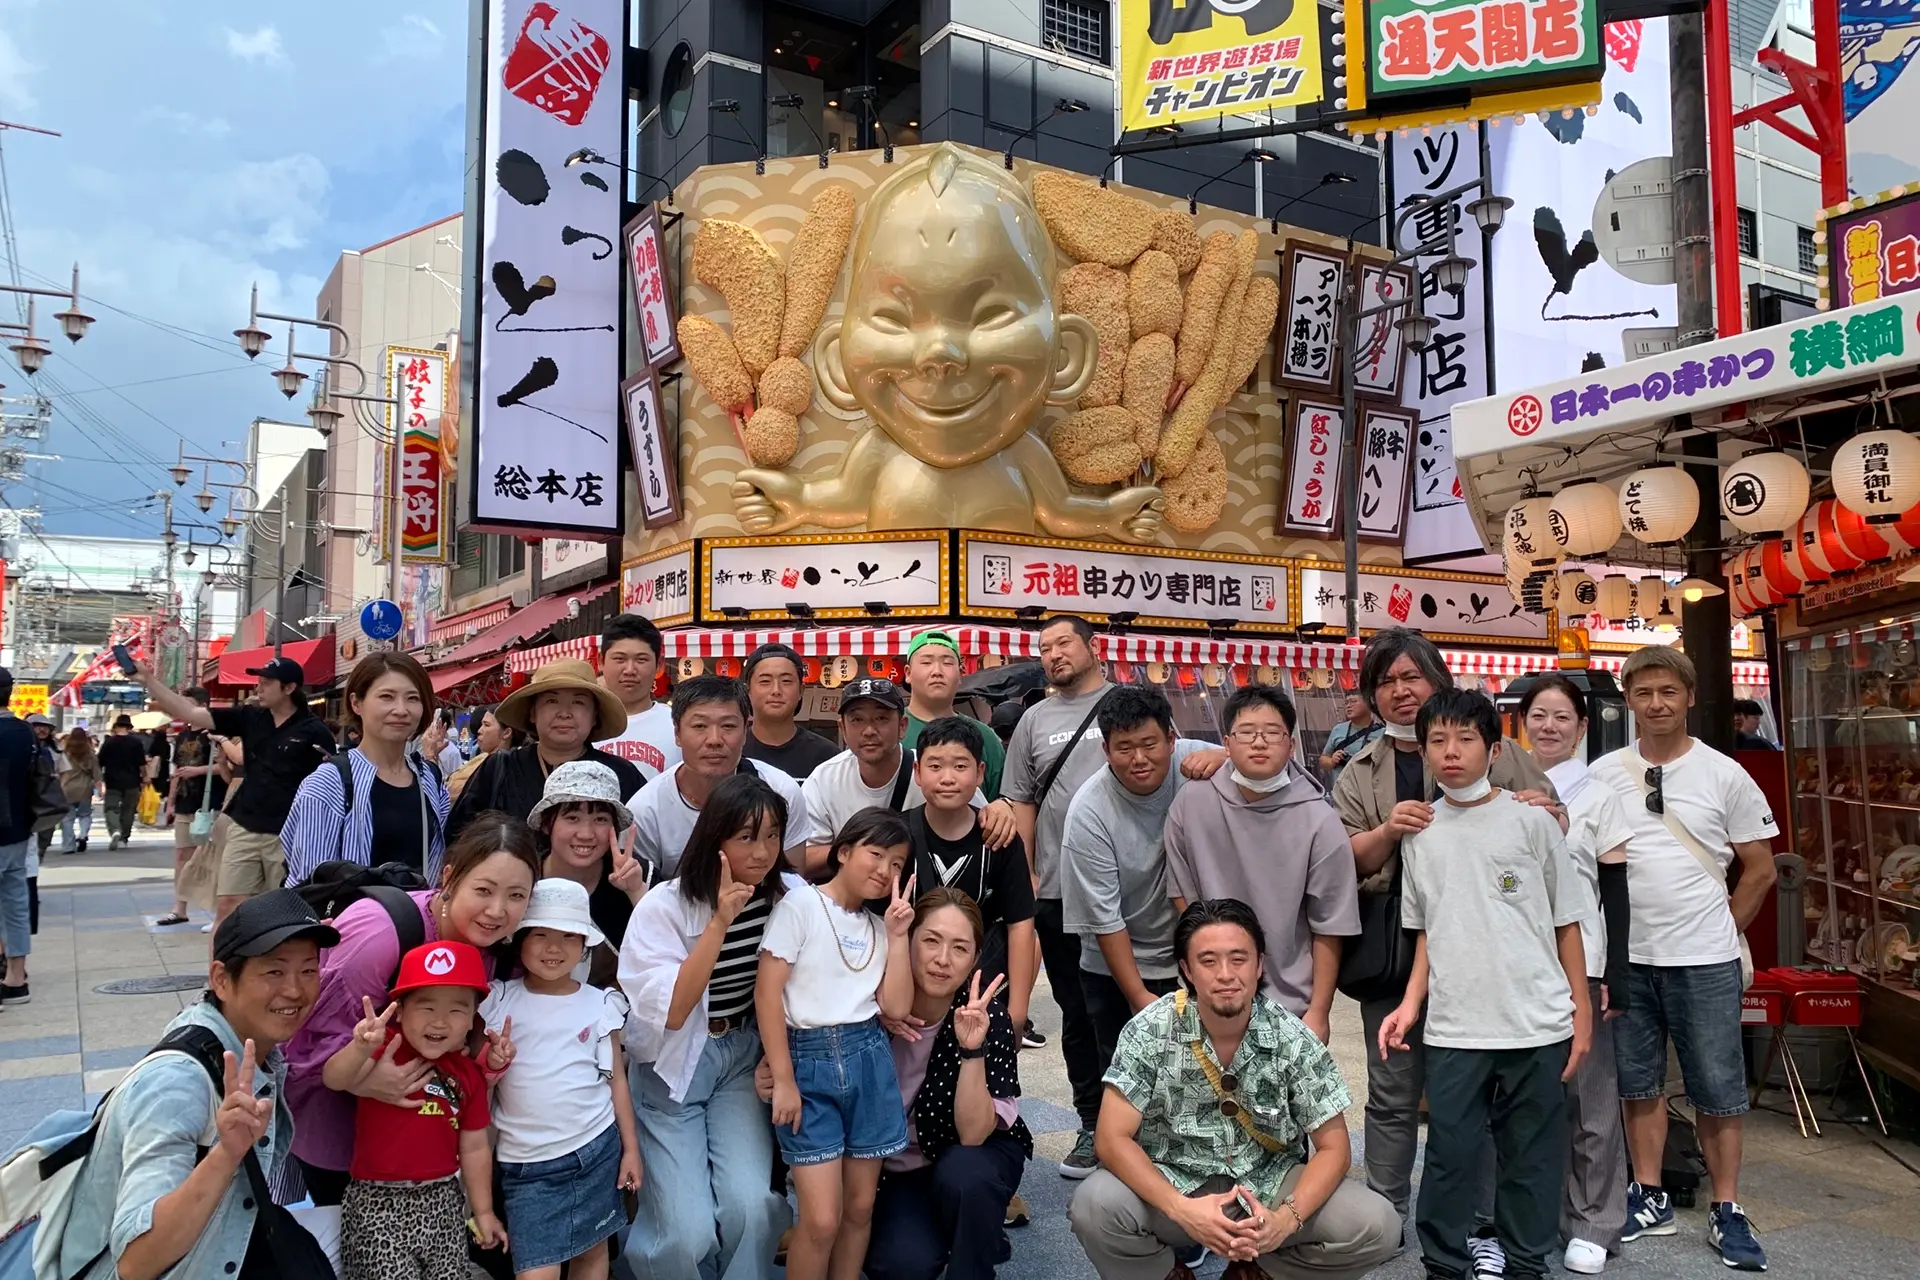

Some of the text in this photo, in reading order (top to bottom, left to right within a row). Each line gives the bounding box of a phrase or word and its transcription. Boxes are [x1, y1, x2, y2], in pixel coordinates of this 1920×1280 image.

[1147, 37, 1301, 81] 新世界遊技場
[1384, 0, 1579, 76] 通天閣店
[1145, 66, 1306, 116] チャンピオン
[1310, 268, 1336, 370] アスパラ
[1551, 304, 1904, 425] 日本一の串かつ 横綱
[401, 358, 436, 532] 餃子の 王将
[639, 400, 661, 498] うずら
[1301, 413, 1331, 519] 紅しょうが
[494, 464, 605, 507] 総本店
[1625, 480, 1649, 532] どて焼
[1023, 562, 1242, 607] 元祖串カツ専門店
[616, 740, 665, 773] DESIGN
[427, 952, 452, 969] M
[1808, 999, 1851, 1007] すいがら入れ
[794, 1151, 820, 1163] Everyday
[852, 1151, 874, 1160] Always
[881, 1147, 895, 1156] Cute
